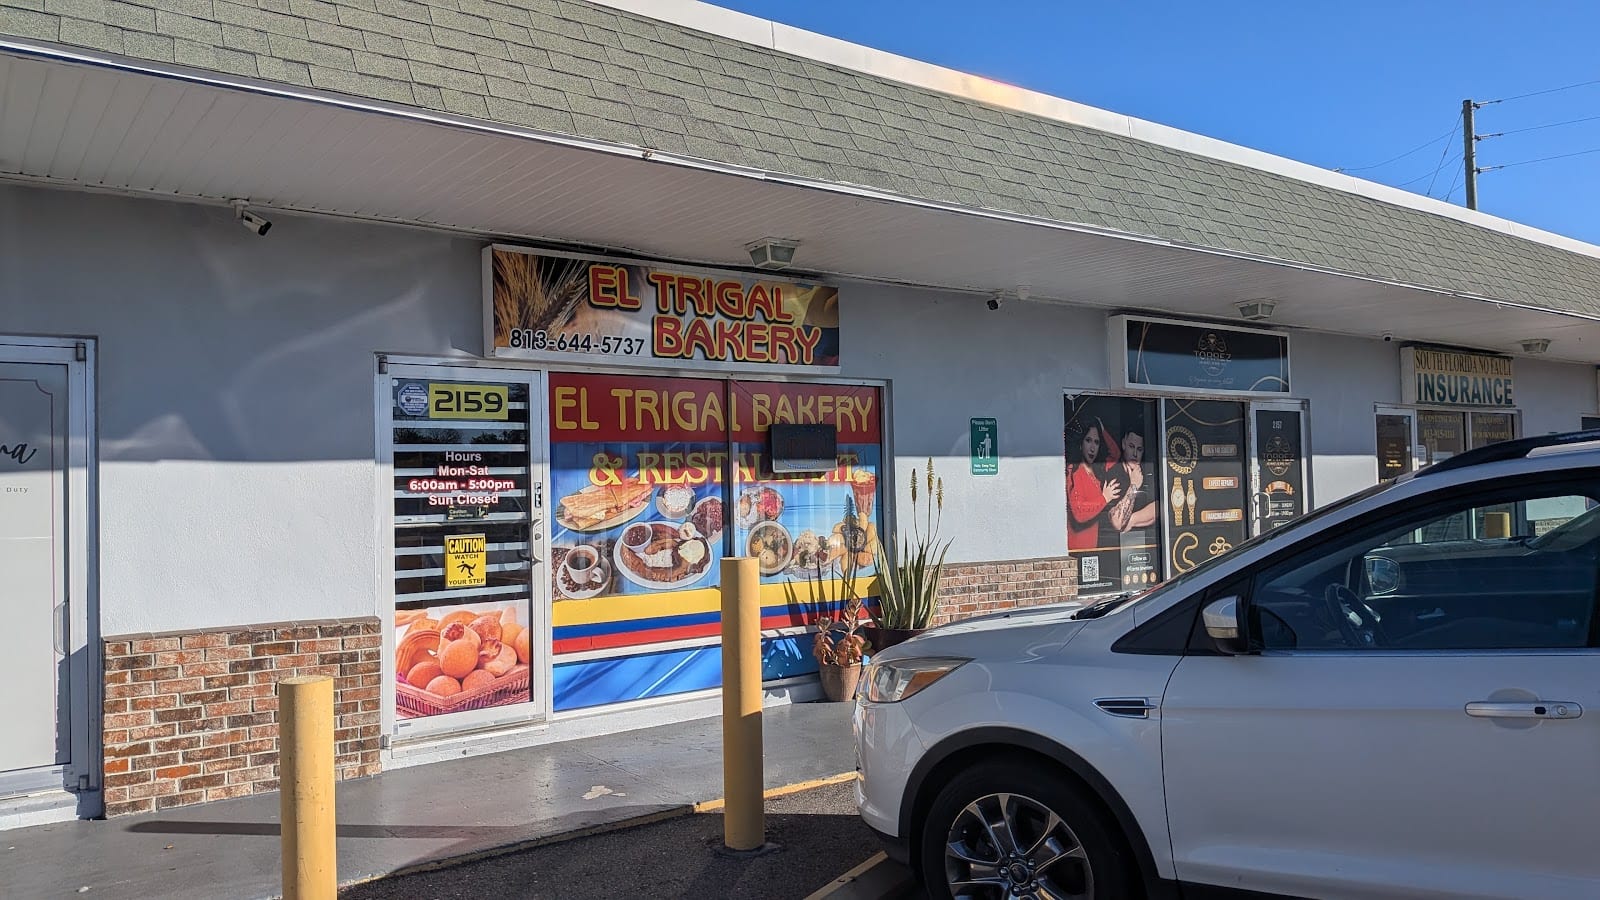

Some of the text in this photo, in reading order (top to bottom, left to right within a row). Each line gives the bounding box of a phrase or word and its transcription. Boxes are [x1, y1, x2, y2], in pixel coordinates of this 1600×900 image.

[589, 264, 795, 322] EL TRIGAL
[510, 329, 645, 356] 813-644-5737
[653, 315, 821, 365] BAKERY
[1193, 351, 1231, 362] TORREZ
[1415, 350, 1512, 376] SOUTH FLORIDA NO FAULT
[434, 390, 503, 412] 2159
[1417, 373, 1512, 404] INSURANCE
[555, 386, 873, 432] EL TRIGAL BAKERY
[445, 451, 482, 462] Hours
[438, 465, 489, 476] Mon-Sat
[589, 452, 624, 487] &
[409, 480, 458, 490] 6:00am
[469, 479, 515, 491] 5:00pm
[534, 482, 542, 507] PULL
[428, 494, 499, 506] Sun Closed
[449, 538, 484, 554] CAUTION
